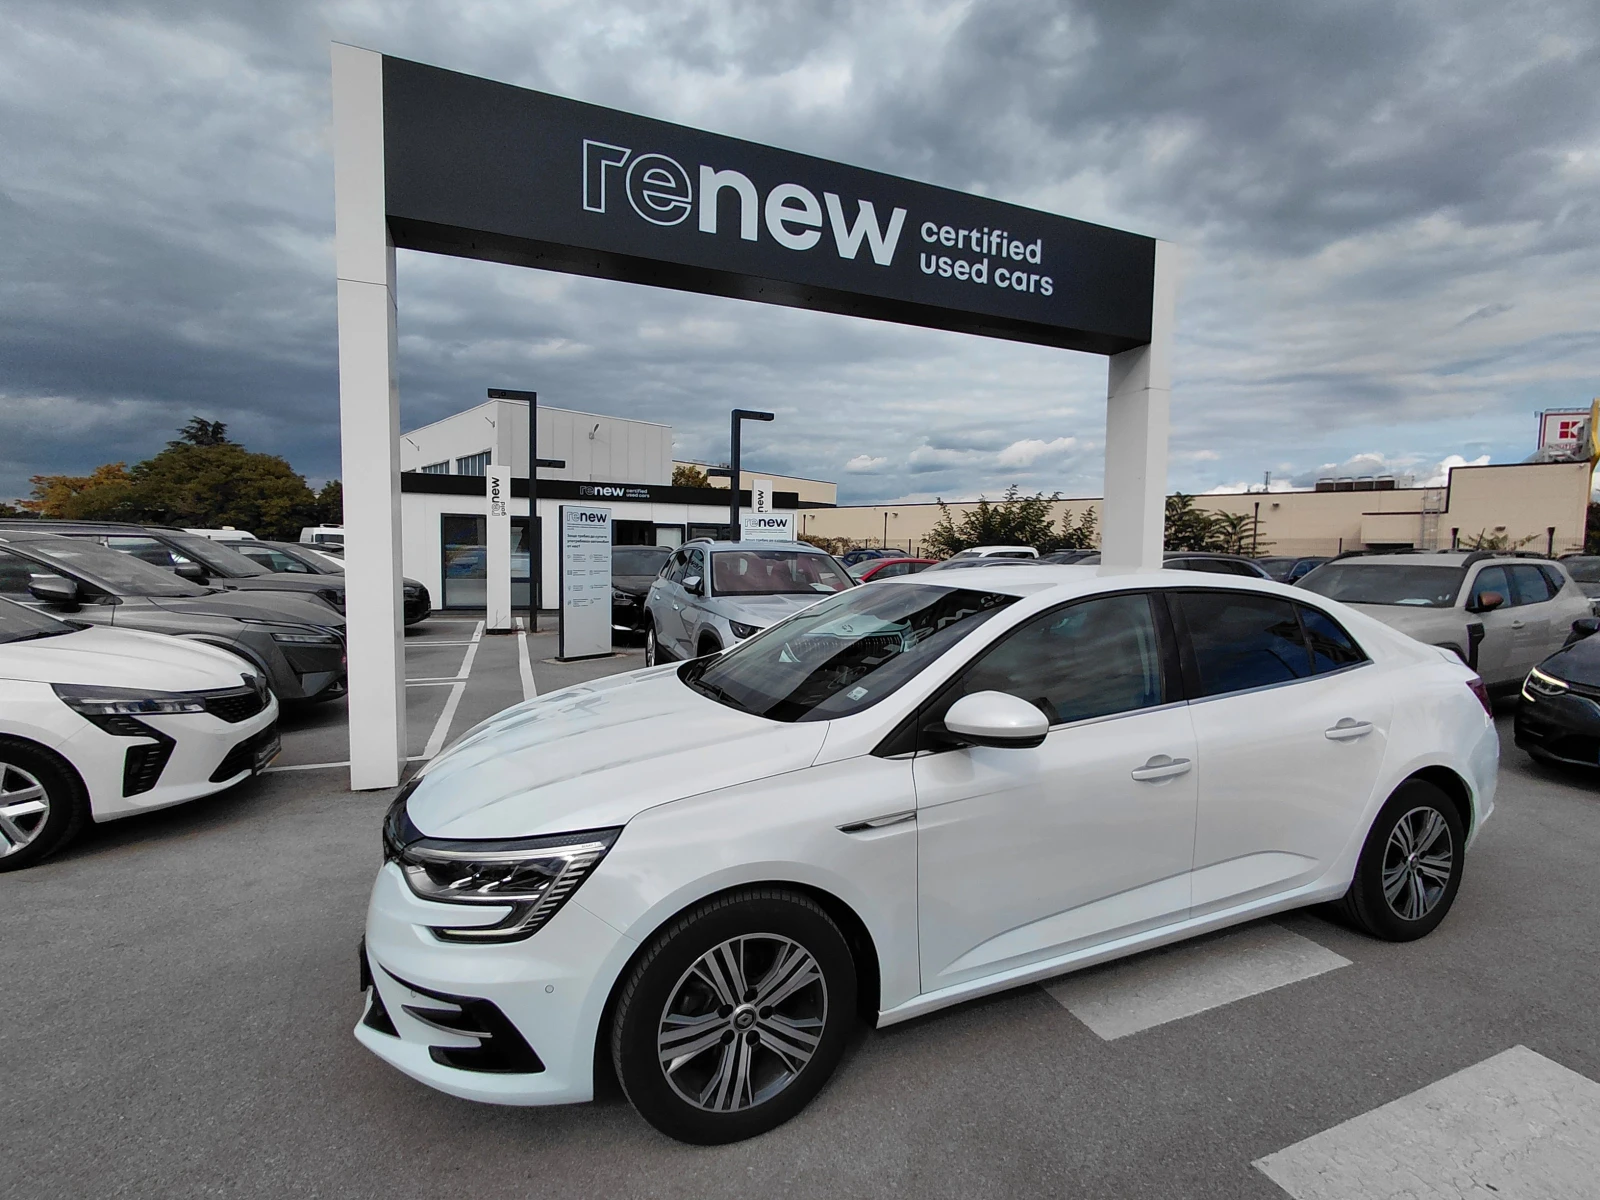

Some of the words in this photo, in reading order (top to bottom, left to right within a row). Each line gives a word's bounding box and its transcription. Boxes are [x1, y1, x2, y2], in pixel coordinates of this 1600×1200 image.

[583, 138, 908, 266] renew
[920, 221, 1042, 265] certified
[919, 251, 987, 285] used
[993, 264, 1055, 296] cars
[491, 476, 500, 516] renew
[580, 485, 625, 497] renew
[566, 511, 607, 523] renew
[745, 518, 788, 528] renew
